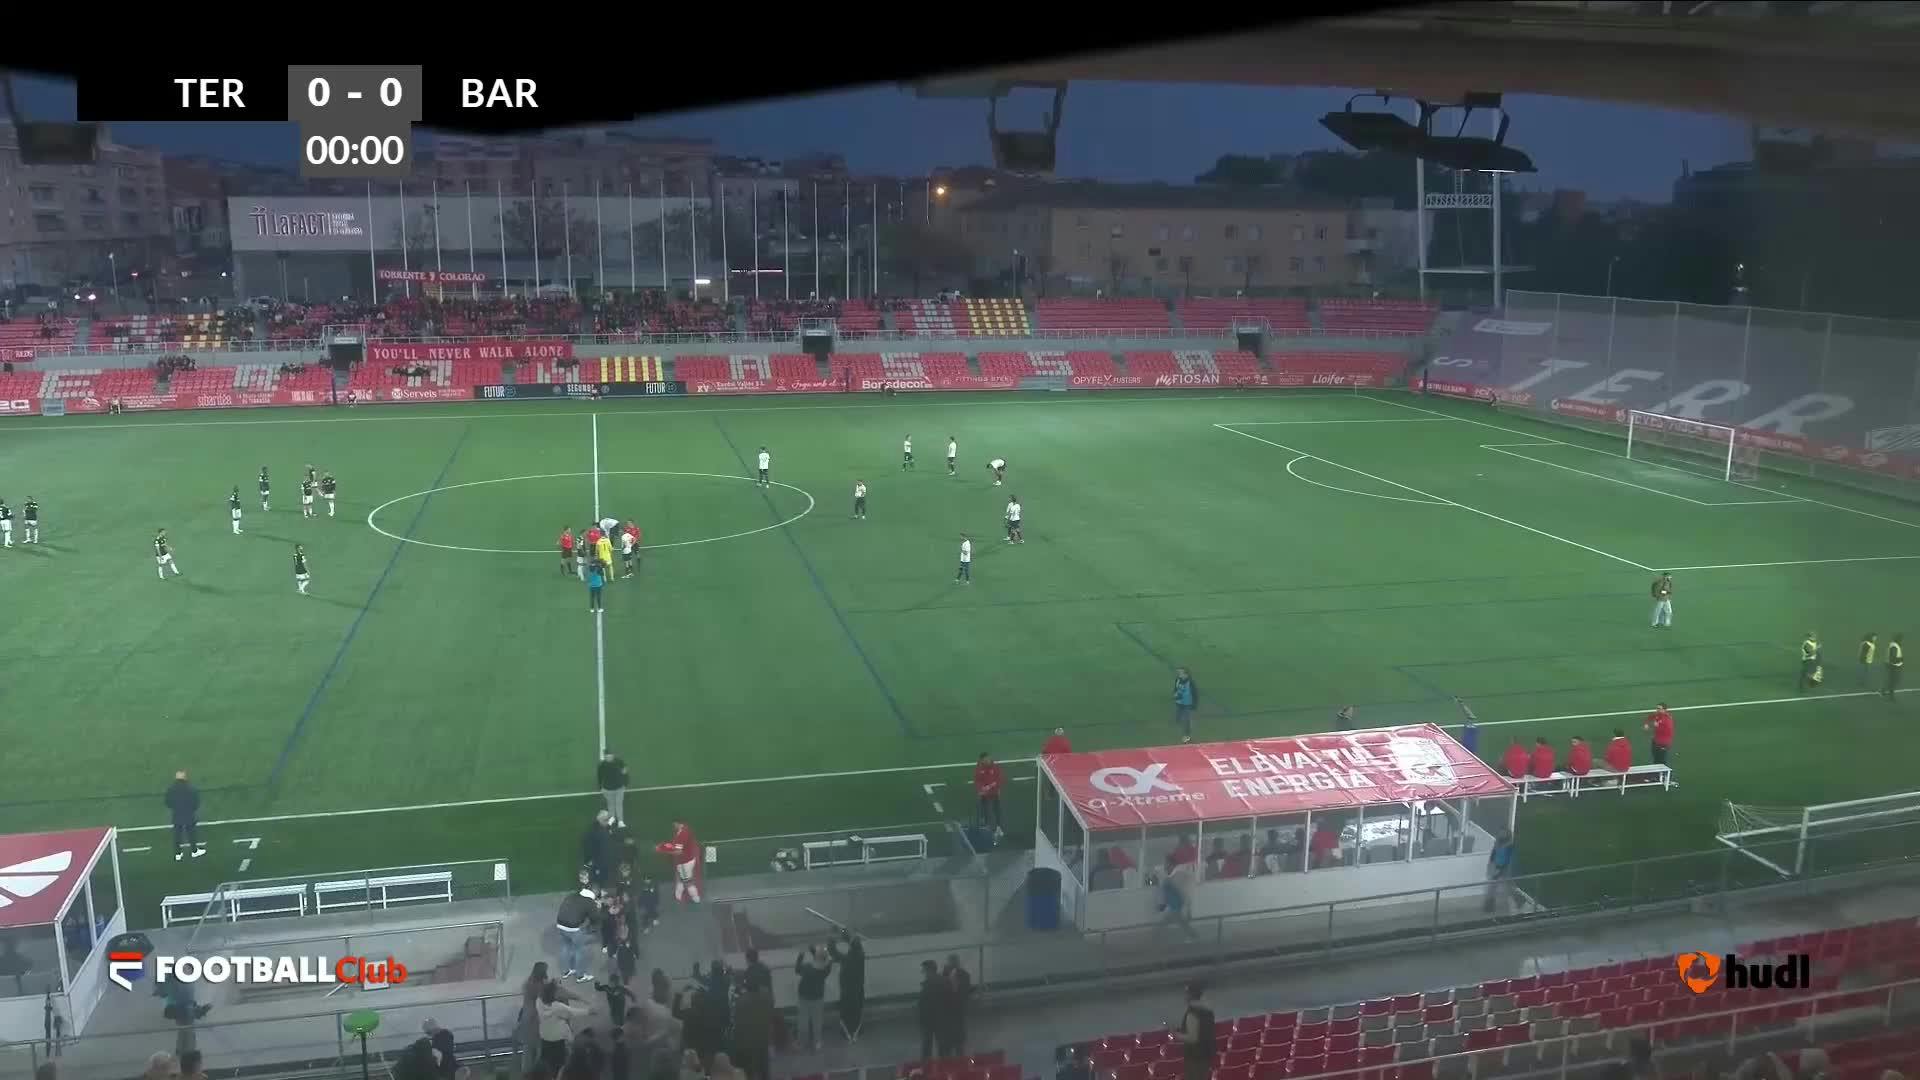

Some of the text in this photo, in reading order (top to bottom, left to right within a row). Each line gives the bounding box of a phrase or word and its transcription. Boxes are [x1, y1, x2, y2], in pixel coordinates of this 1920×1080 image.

[373, 345, 565, 360] YOU'LL NEVER WALK ALONE
[484, 385, 505, 398] FUTUR
[645, 382, 666, 394] FUTUR
